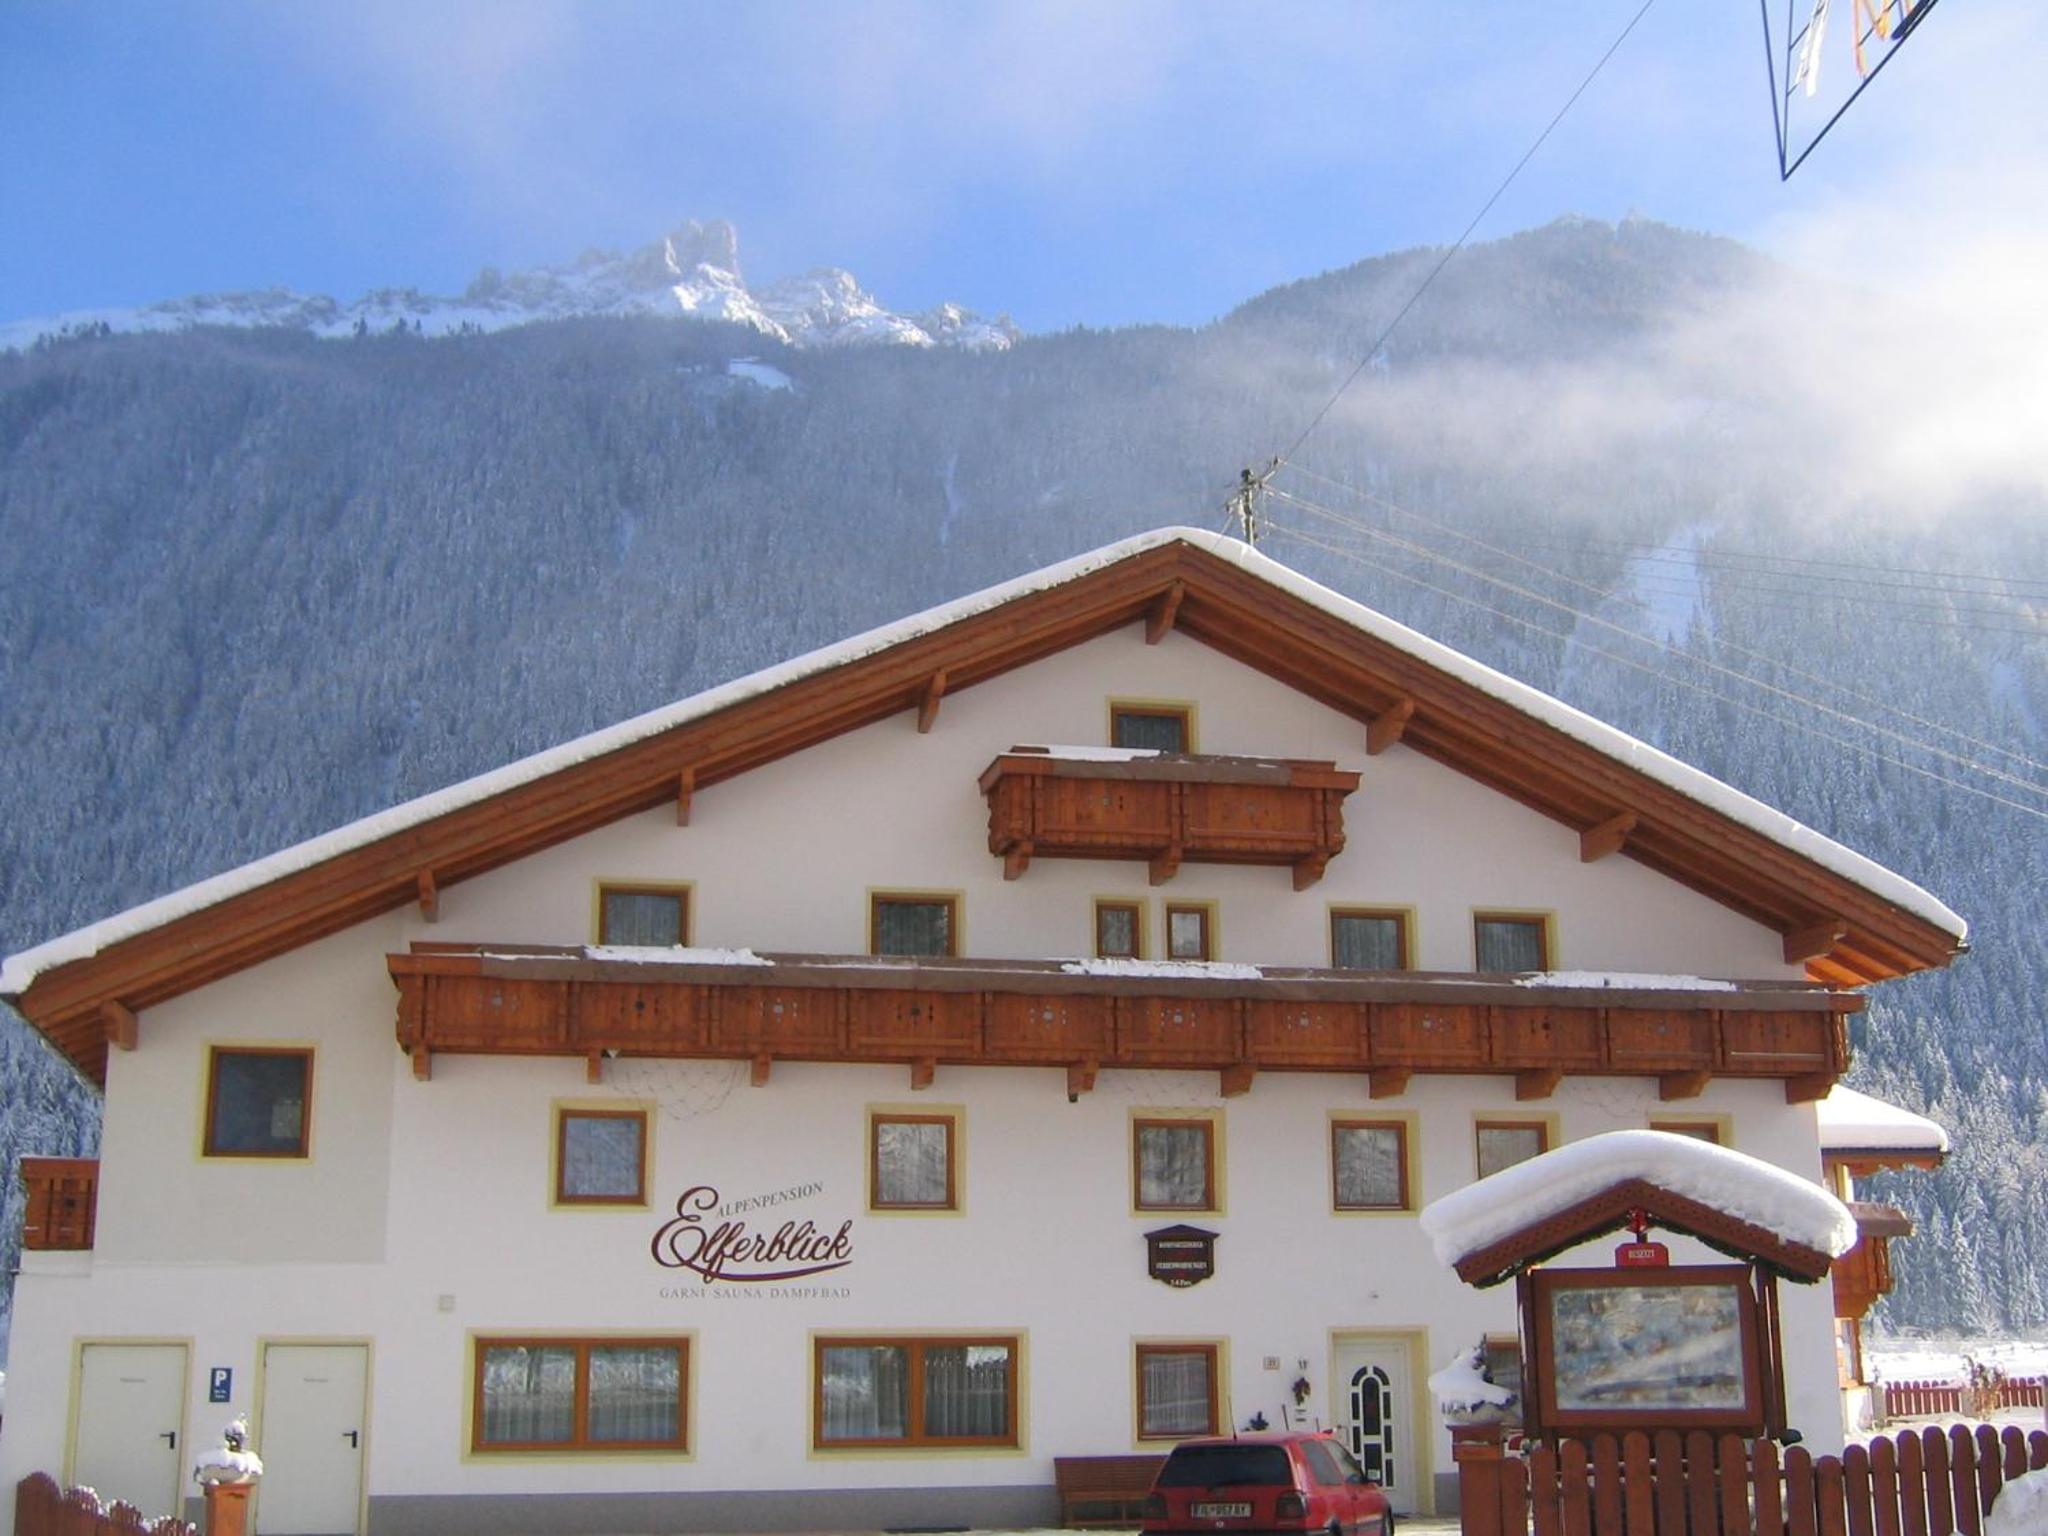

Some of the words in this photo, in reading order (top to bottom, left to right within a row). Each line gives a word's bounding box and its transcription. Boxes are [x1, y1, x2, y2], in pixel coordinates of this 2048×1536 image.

[716, 1180, 823, 1217] ALPENPENSION
[651, 1185, 853, 1284] Elferblick
[659, 1286, 706, 1300] GARNI
[713, 1286, 762, 1299] SAUNA
[770, 1286, 851, 1299] DAMPFBAD
[215, 1370, 228, 1387] P
